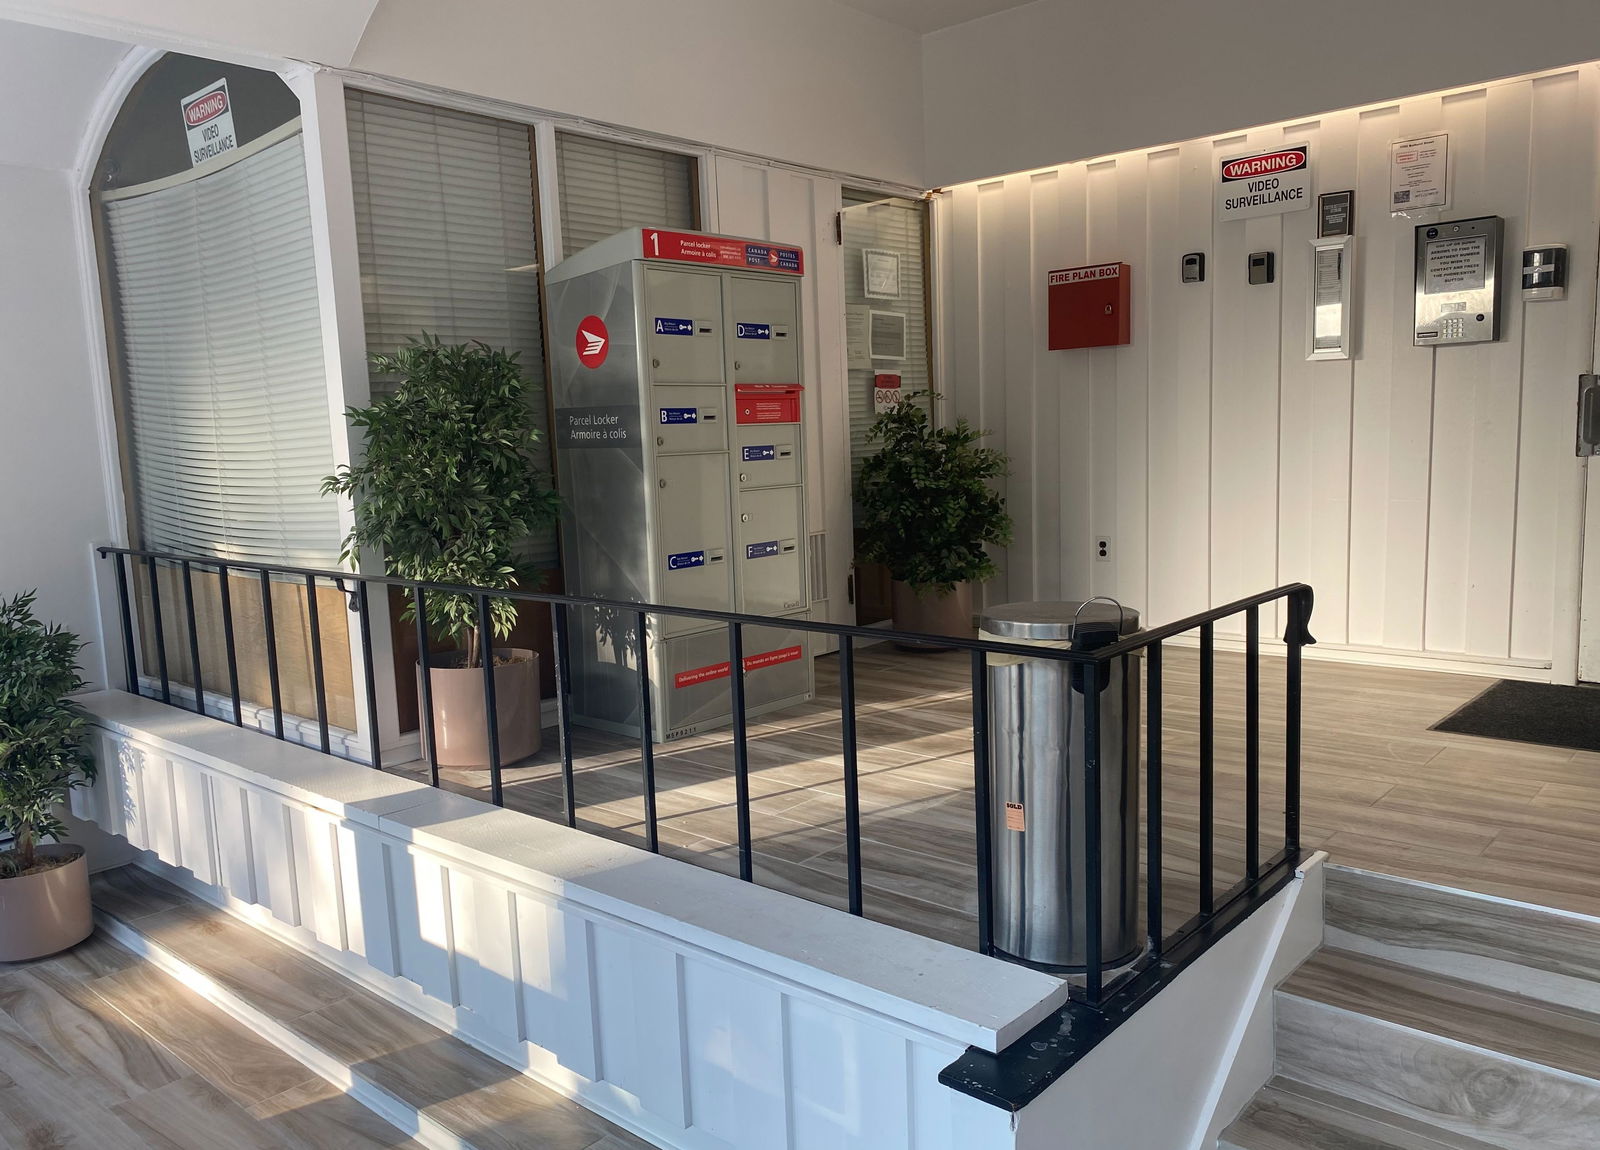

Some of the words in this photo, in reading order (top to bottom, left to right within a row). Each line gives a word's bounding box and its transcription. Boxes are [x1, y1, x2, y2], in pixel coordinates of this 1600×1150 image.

[188, 95, 223, 123] WARNING
[201, 123, 220, 142] VIDEO
[193, 134, 234, 164] SURVEILLANCE
[1230, 154, 1297, 176] WARNING
[1247, 178, 1280, 193] VIDEO
[1225, 187, 1304, 210] SURVEILLANCE
[650, 232, 659, 256] 1
[680, 249, 701, 257] Armoire
[747, 247, 768, 256] CANADA
[1050, 273, 1070, 283] FIRE
[1072, 269, 1096, 281] PLAN
[1099, 266, 1118, 277] BOX
[656, 319, 664, 333] A
[737, 324, 745, 337] D
[569, 414, 592, 426] Parcel
[593, 413, 619, 426] Locker
[661, 410, 668, 423] B
[570, 428, 601, 440] Armoire
[602, 428, 608, 439] à
[609, 427, 627, 439] colis
[744, 448, 750, 460] E
[748, 546, 753, 558] F
[669, 556, 677, 569] C
[678, 674, 699, 683] Delivering
[717, 665, 729, 673] world
[1006, 802, 1023, 810] SOLD
